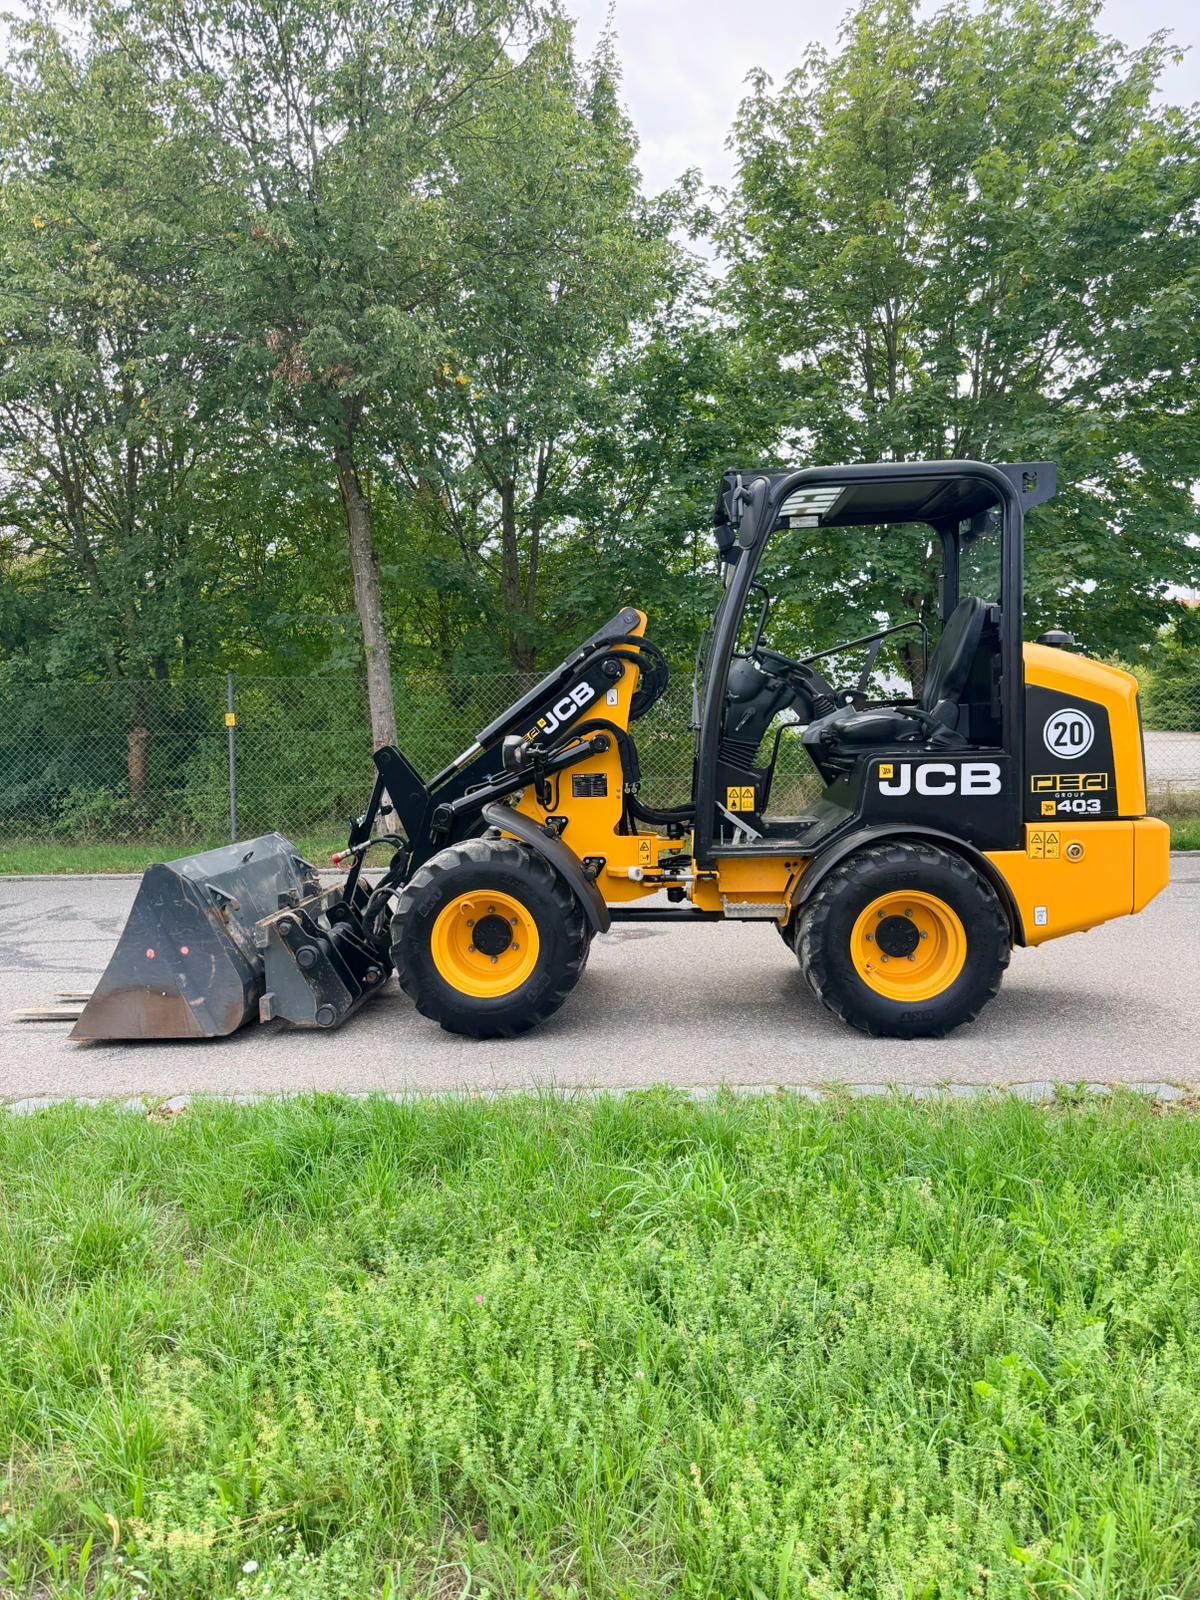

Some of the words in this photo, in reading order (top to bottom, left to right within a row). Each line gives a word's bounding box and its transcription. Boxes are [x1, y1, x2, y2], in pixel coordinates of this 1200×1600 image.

[543, 681, 595, 735] JCB
[1053, 720, 1084, 747] 20
[878, 762, 1002, 796] JCB
[1057, 798, 1101, 813] 403
